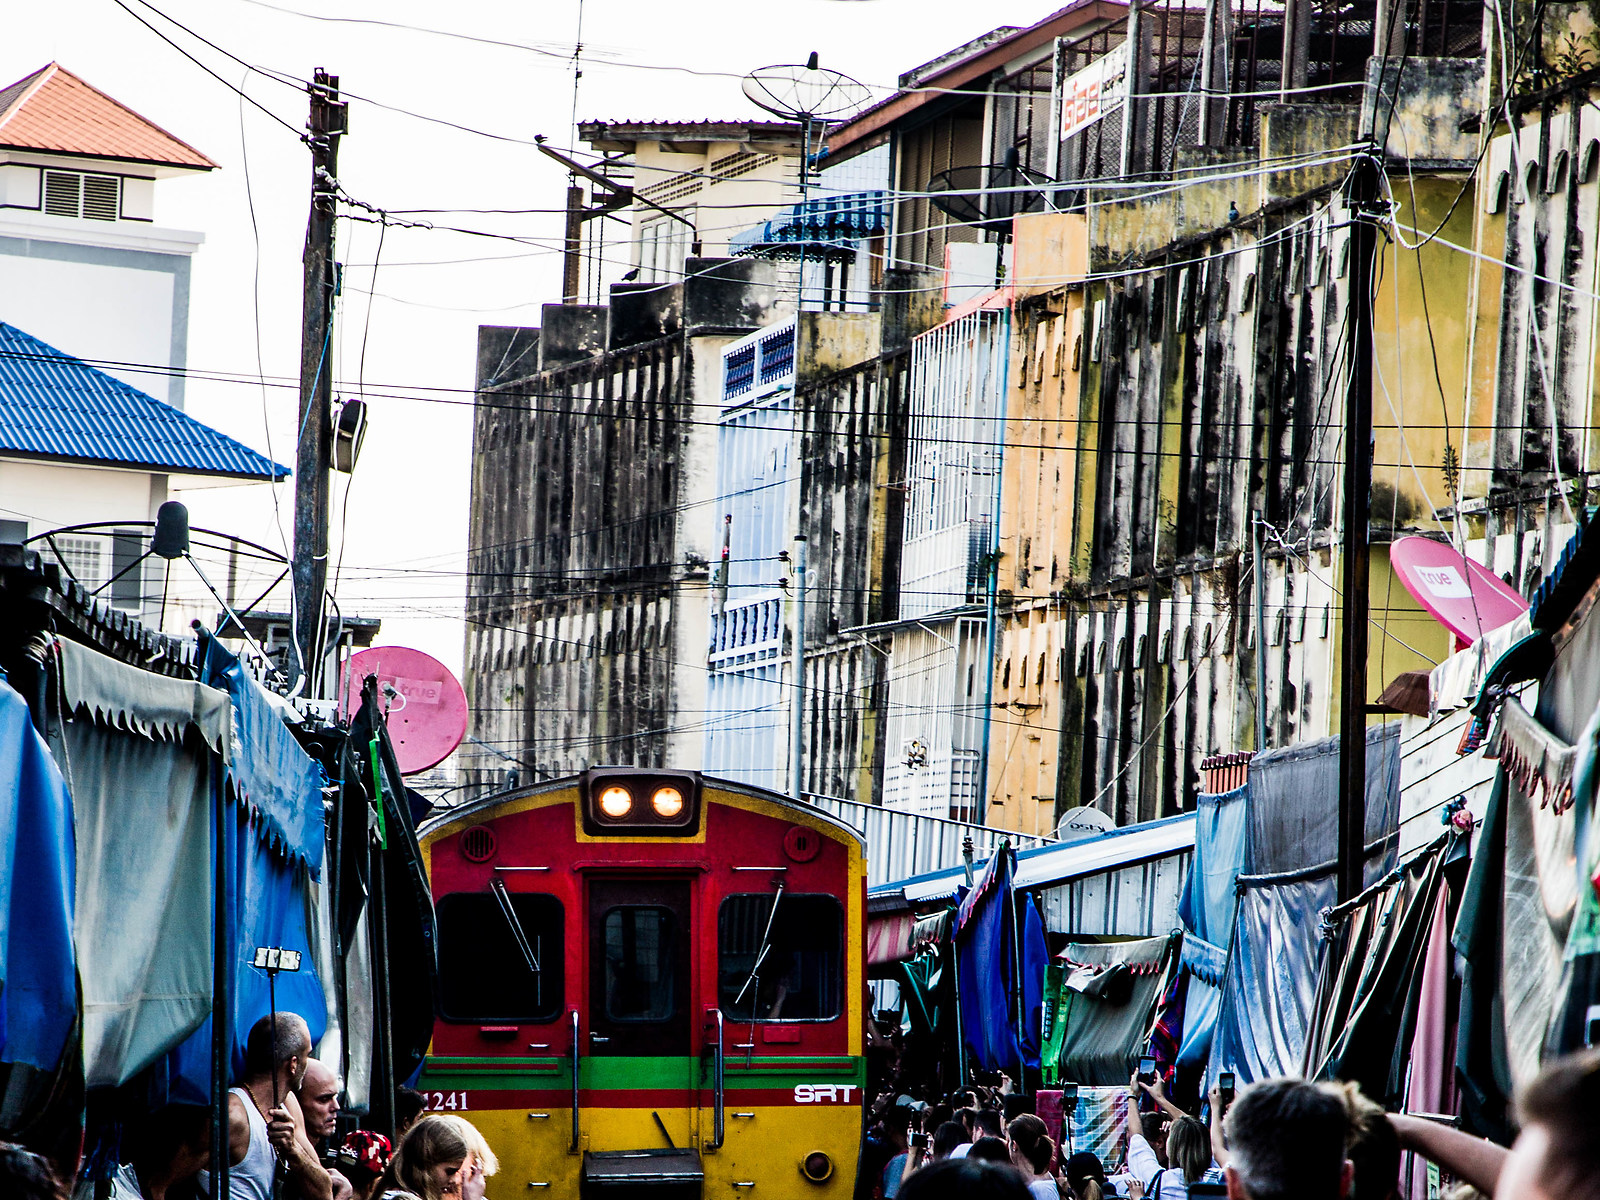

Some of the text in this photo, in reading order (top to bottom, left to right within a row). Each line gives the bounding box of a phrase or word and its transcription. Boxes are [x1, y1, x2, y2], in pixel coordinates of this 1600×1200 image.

[1419, 569, 1452, 585] true
[401, 683, 437, 699] true
[794, 1084, 858, 1103] SRT
